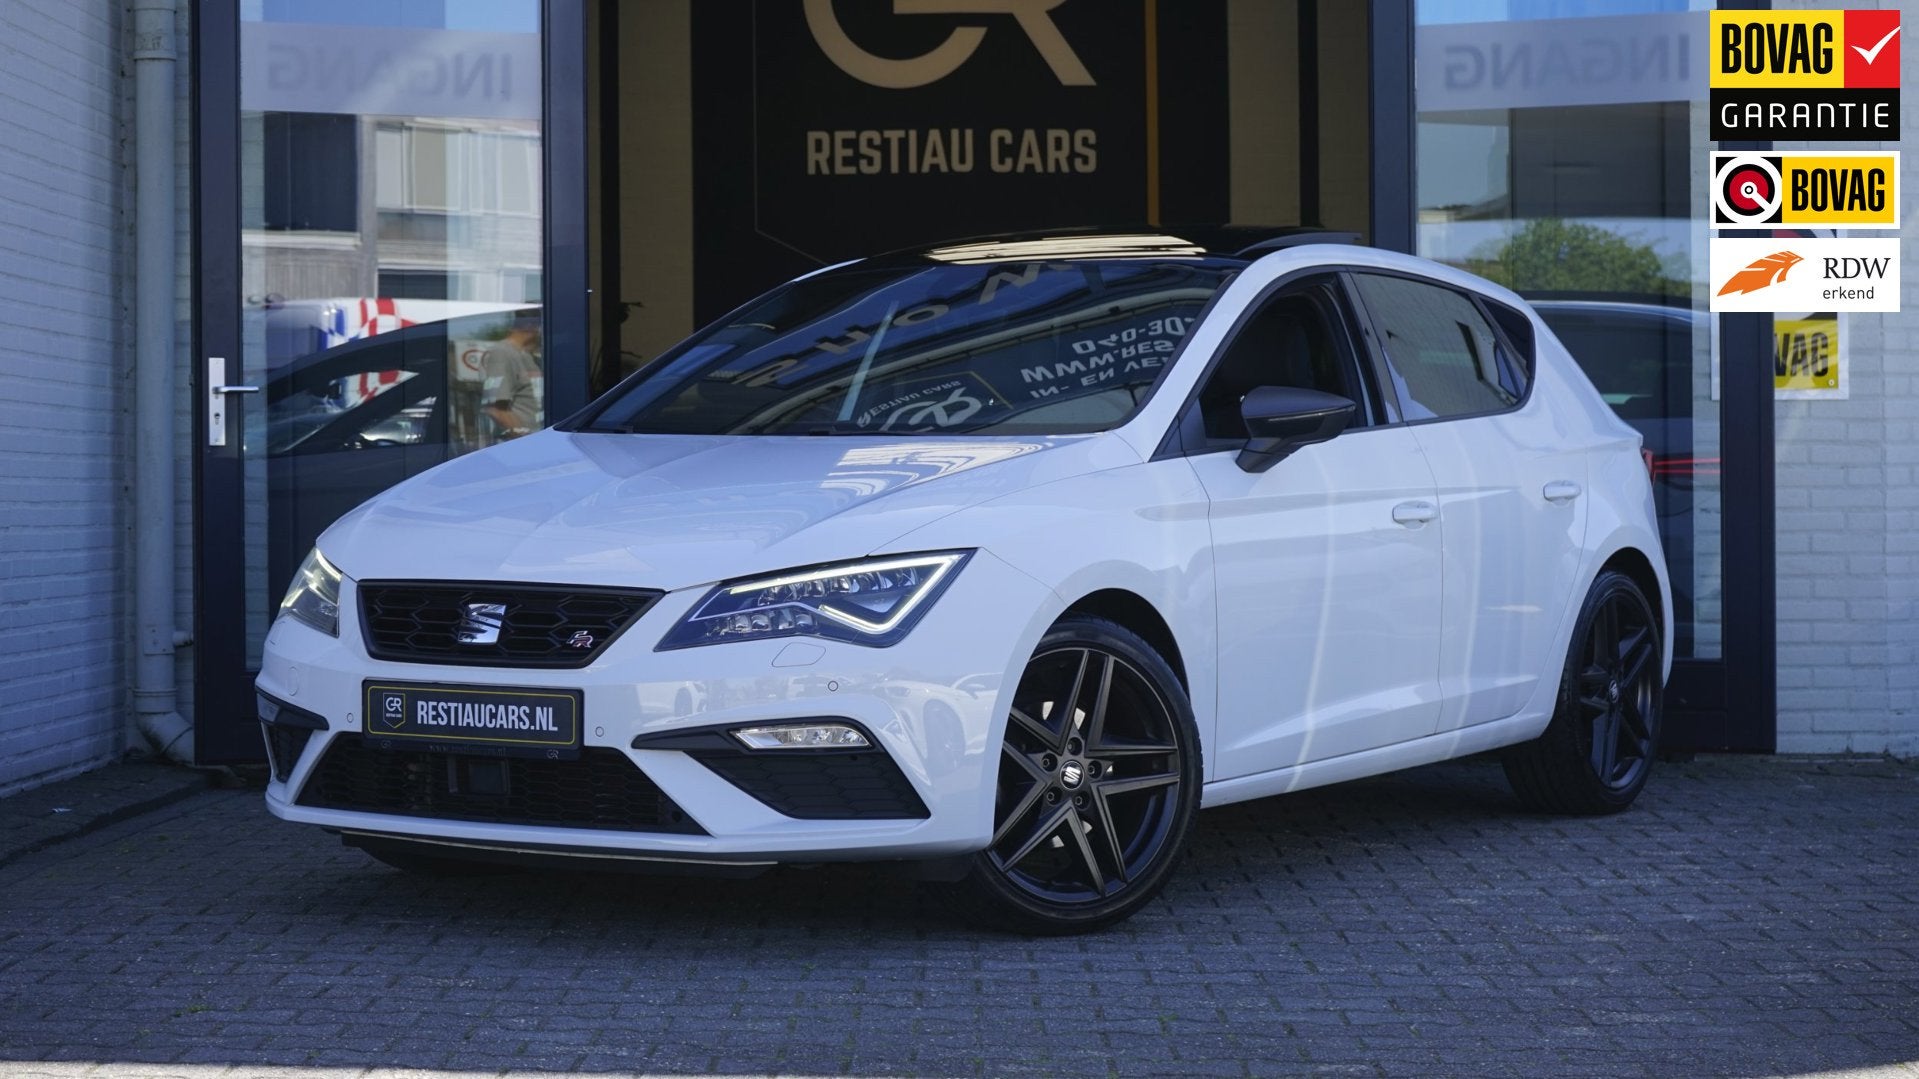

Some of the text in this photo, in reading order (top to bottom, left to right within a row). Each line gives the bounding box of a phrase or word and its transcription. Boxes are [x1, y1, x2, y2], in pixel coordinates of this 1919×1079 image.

[807, 128, 1097, 175] RESTIAU CARS
[1774, 331, 1829, 377] VAG
[416, 700, 559, 732] RESTIAUCARS.NL
